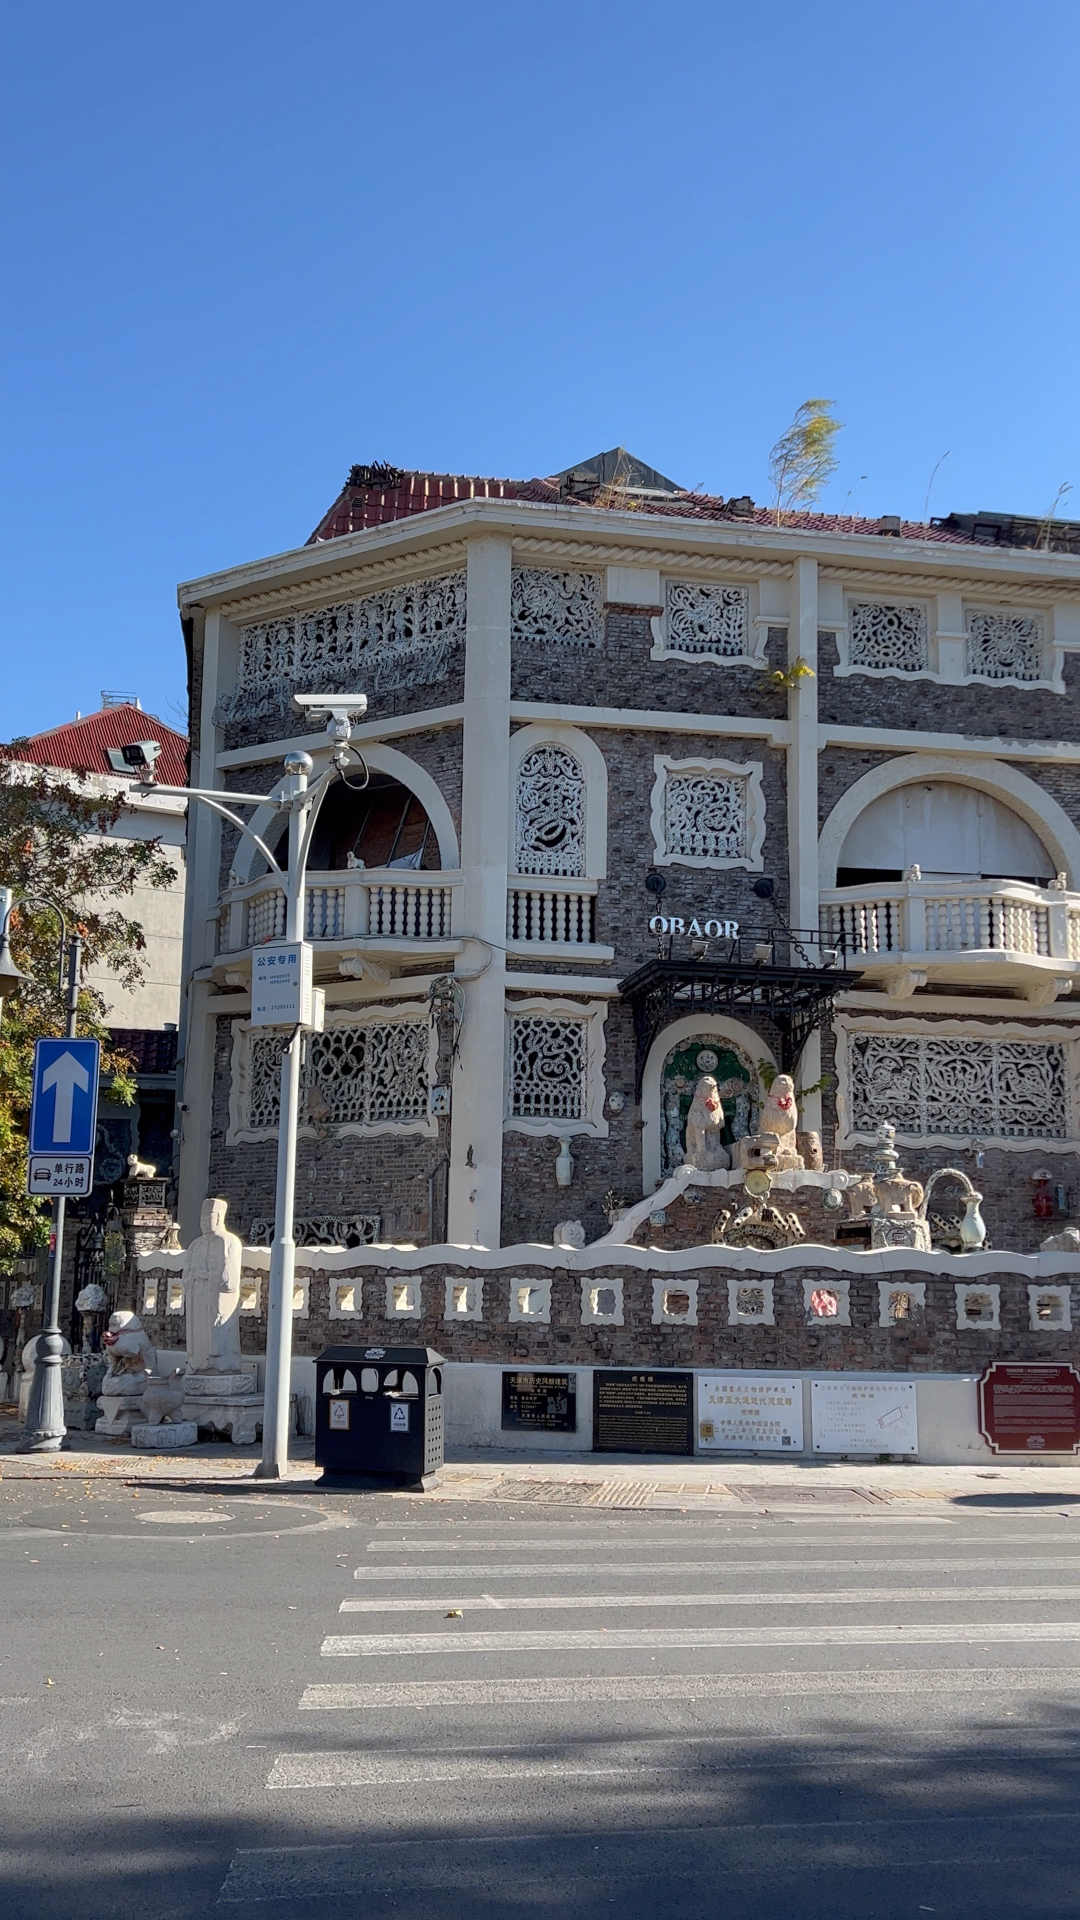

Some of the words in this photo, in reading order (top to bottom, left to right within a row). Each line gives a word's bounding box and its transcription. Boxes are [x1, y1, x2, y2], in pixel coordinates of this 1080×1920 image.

[649, 915, 740, 940] OBAOR
[257, 953, 297, 967] 公安专用
[53, 1162, 85, 1175] 单行路
[53, 1176, 85, 1188] 24小时
[714, 1385, 786, 1394] 全国重点文物保护单位
[707, 1395, 793, 1407] 天津五大道近代建筑群
[720, 1419, 781, 1428] 中华人民共和国国务院
[723, 1434, 778, 1442] 天津市人民政府立
